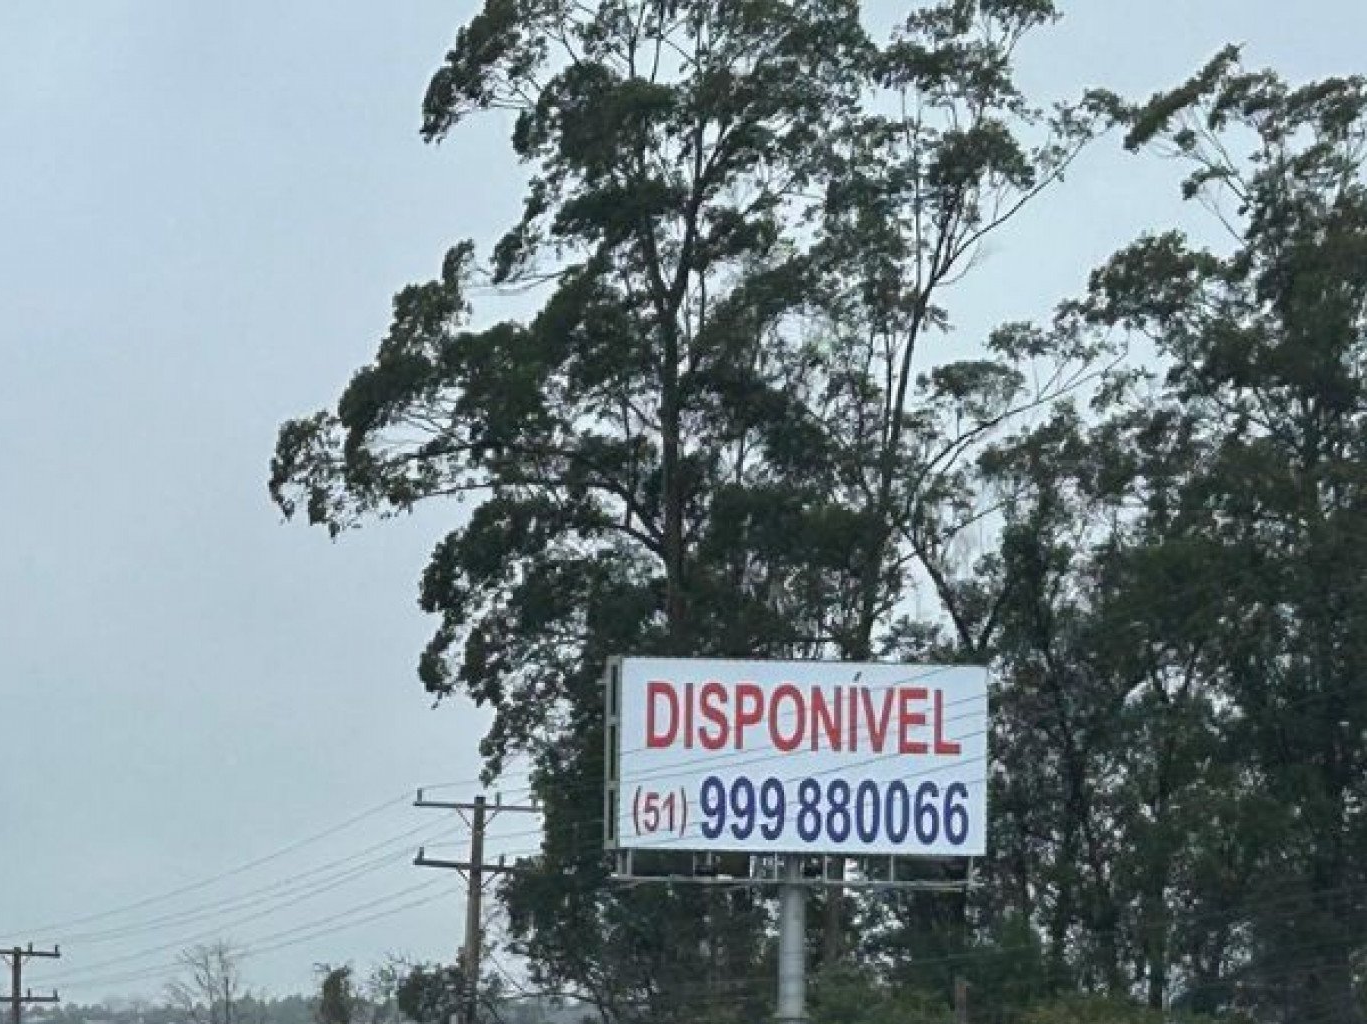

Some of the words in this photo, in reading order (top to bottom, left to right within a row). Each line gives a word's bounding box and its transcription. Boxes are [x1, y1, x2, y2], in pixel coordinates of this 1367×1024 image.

[646, 671, 961, 755] DISPONÍVEL
[633, 786, 688, 837] (51)
[700, 775, 786, 841] 999
[796, 777, 970, 846] 880066
